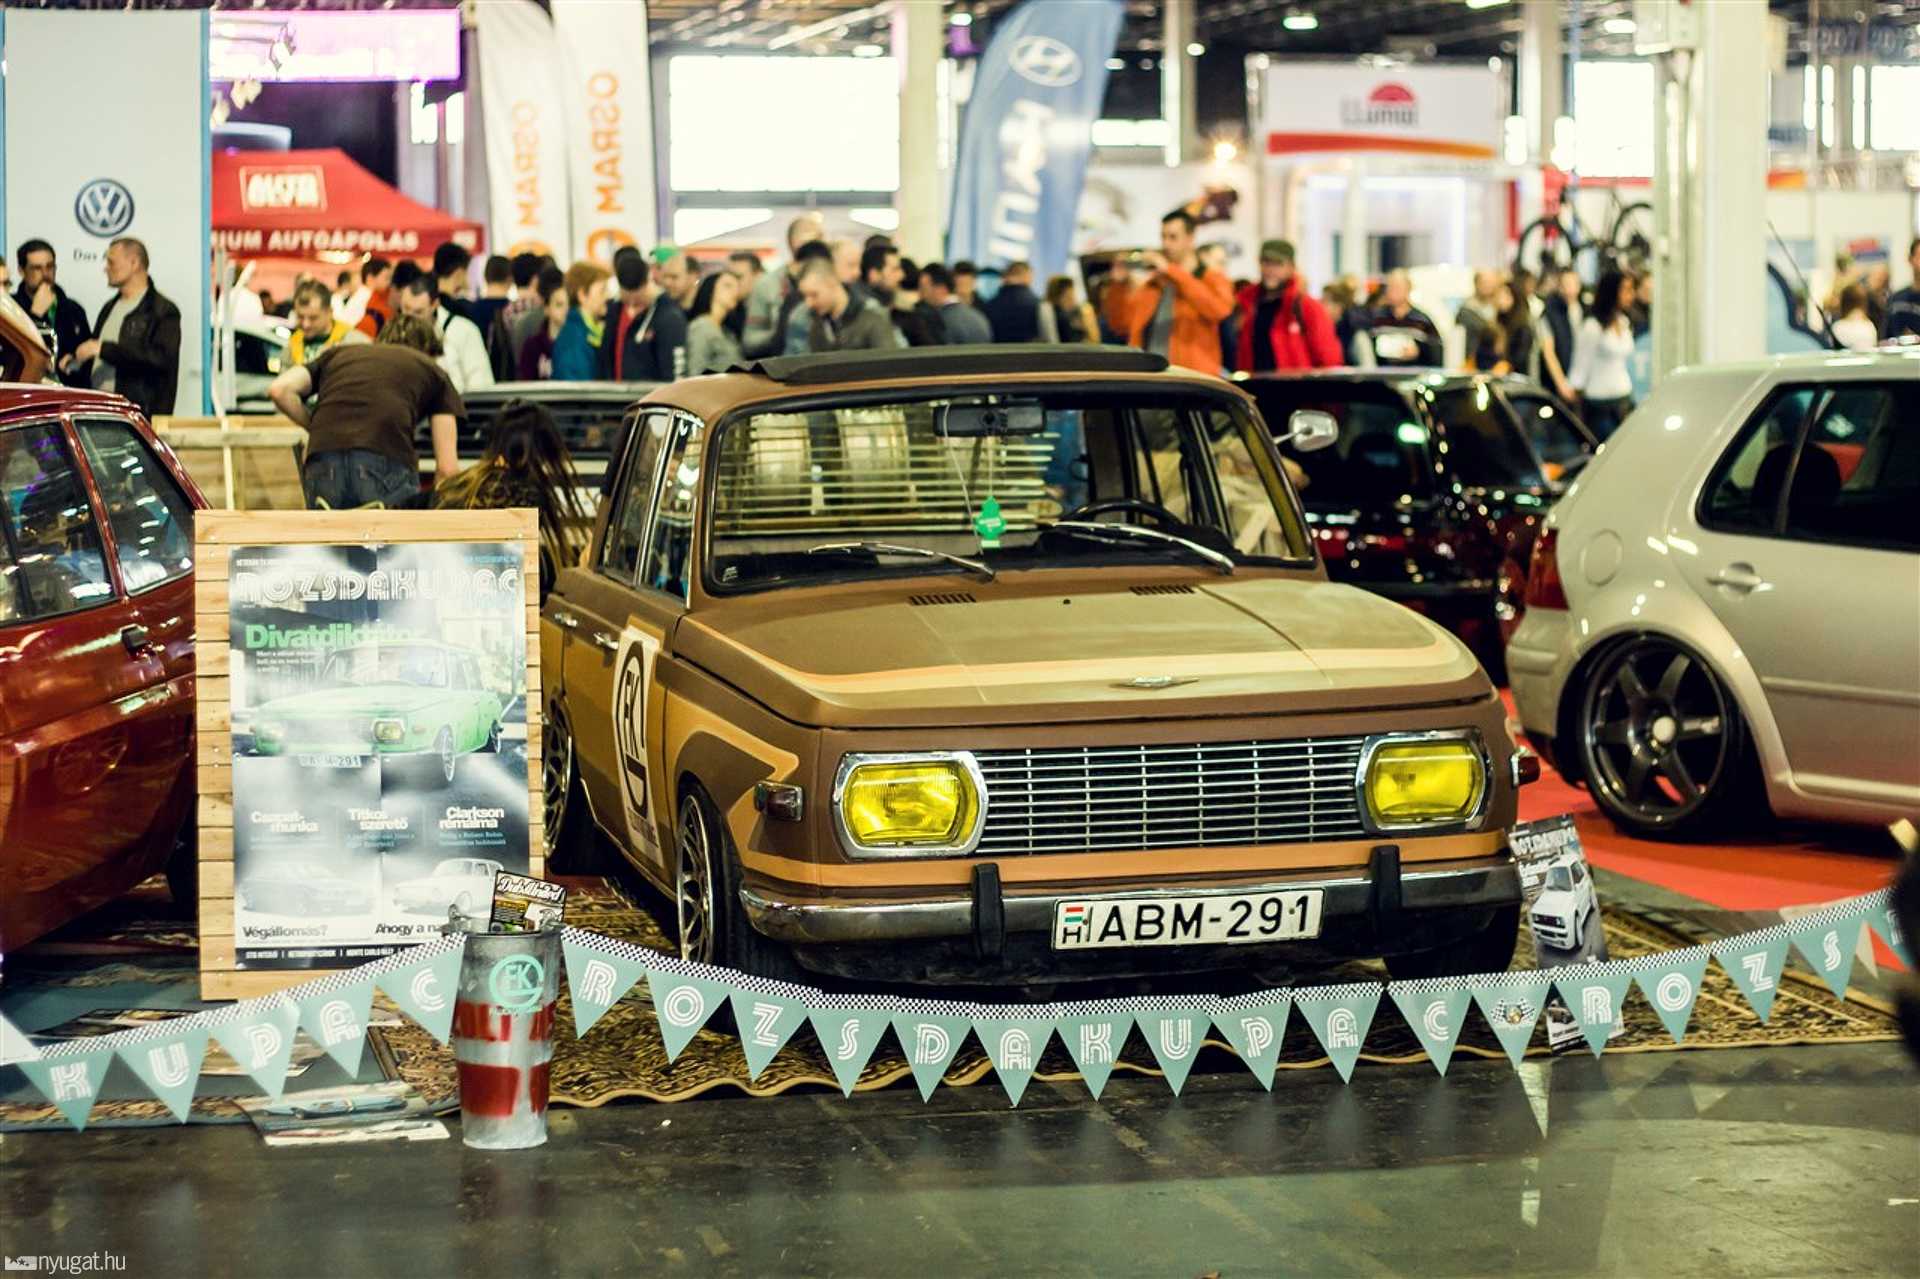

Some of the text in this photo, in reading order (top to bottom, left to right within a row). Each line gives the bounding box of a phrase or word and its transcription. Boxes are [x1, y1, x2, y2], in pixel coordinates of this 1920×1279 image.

[446, 806, 505, 820] Clarkson
[1062, 895, 1309, 944] H ABM-291
[376, 923, 413, 936] Ahogy
